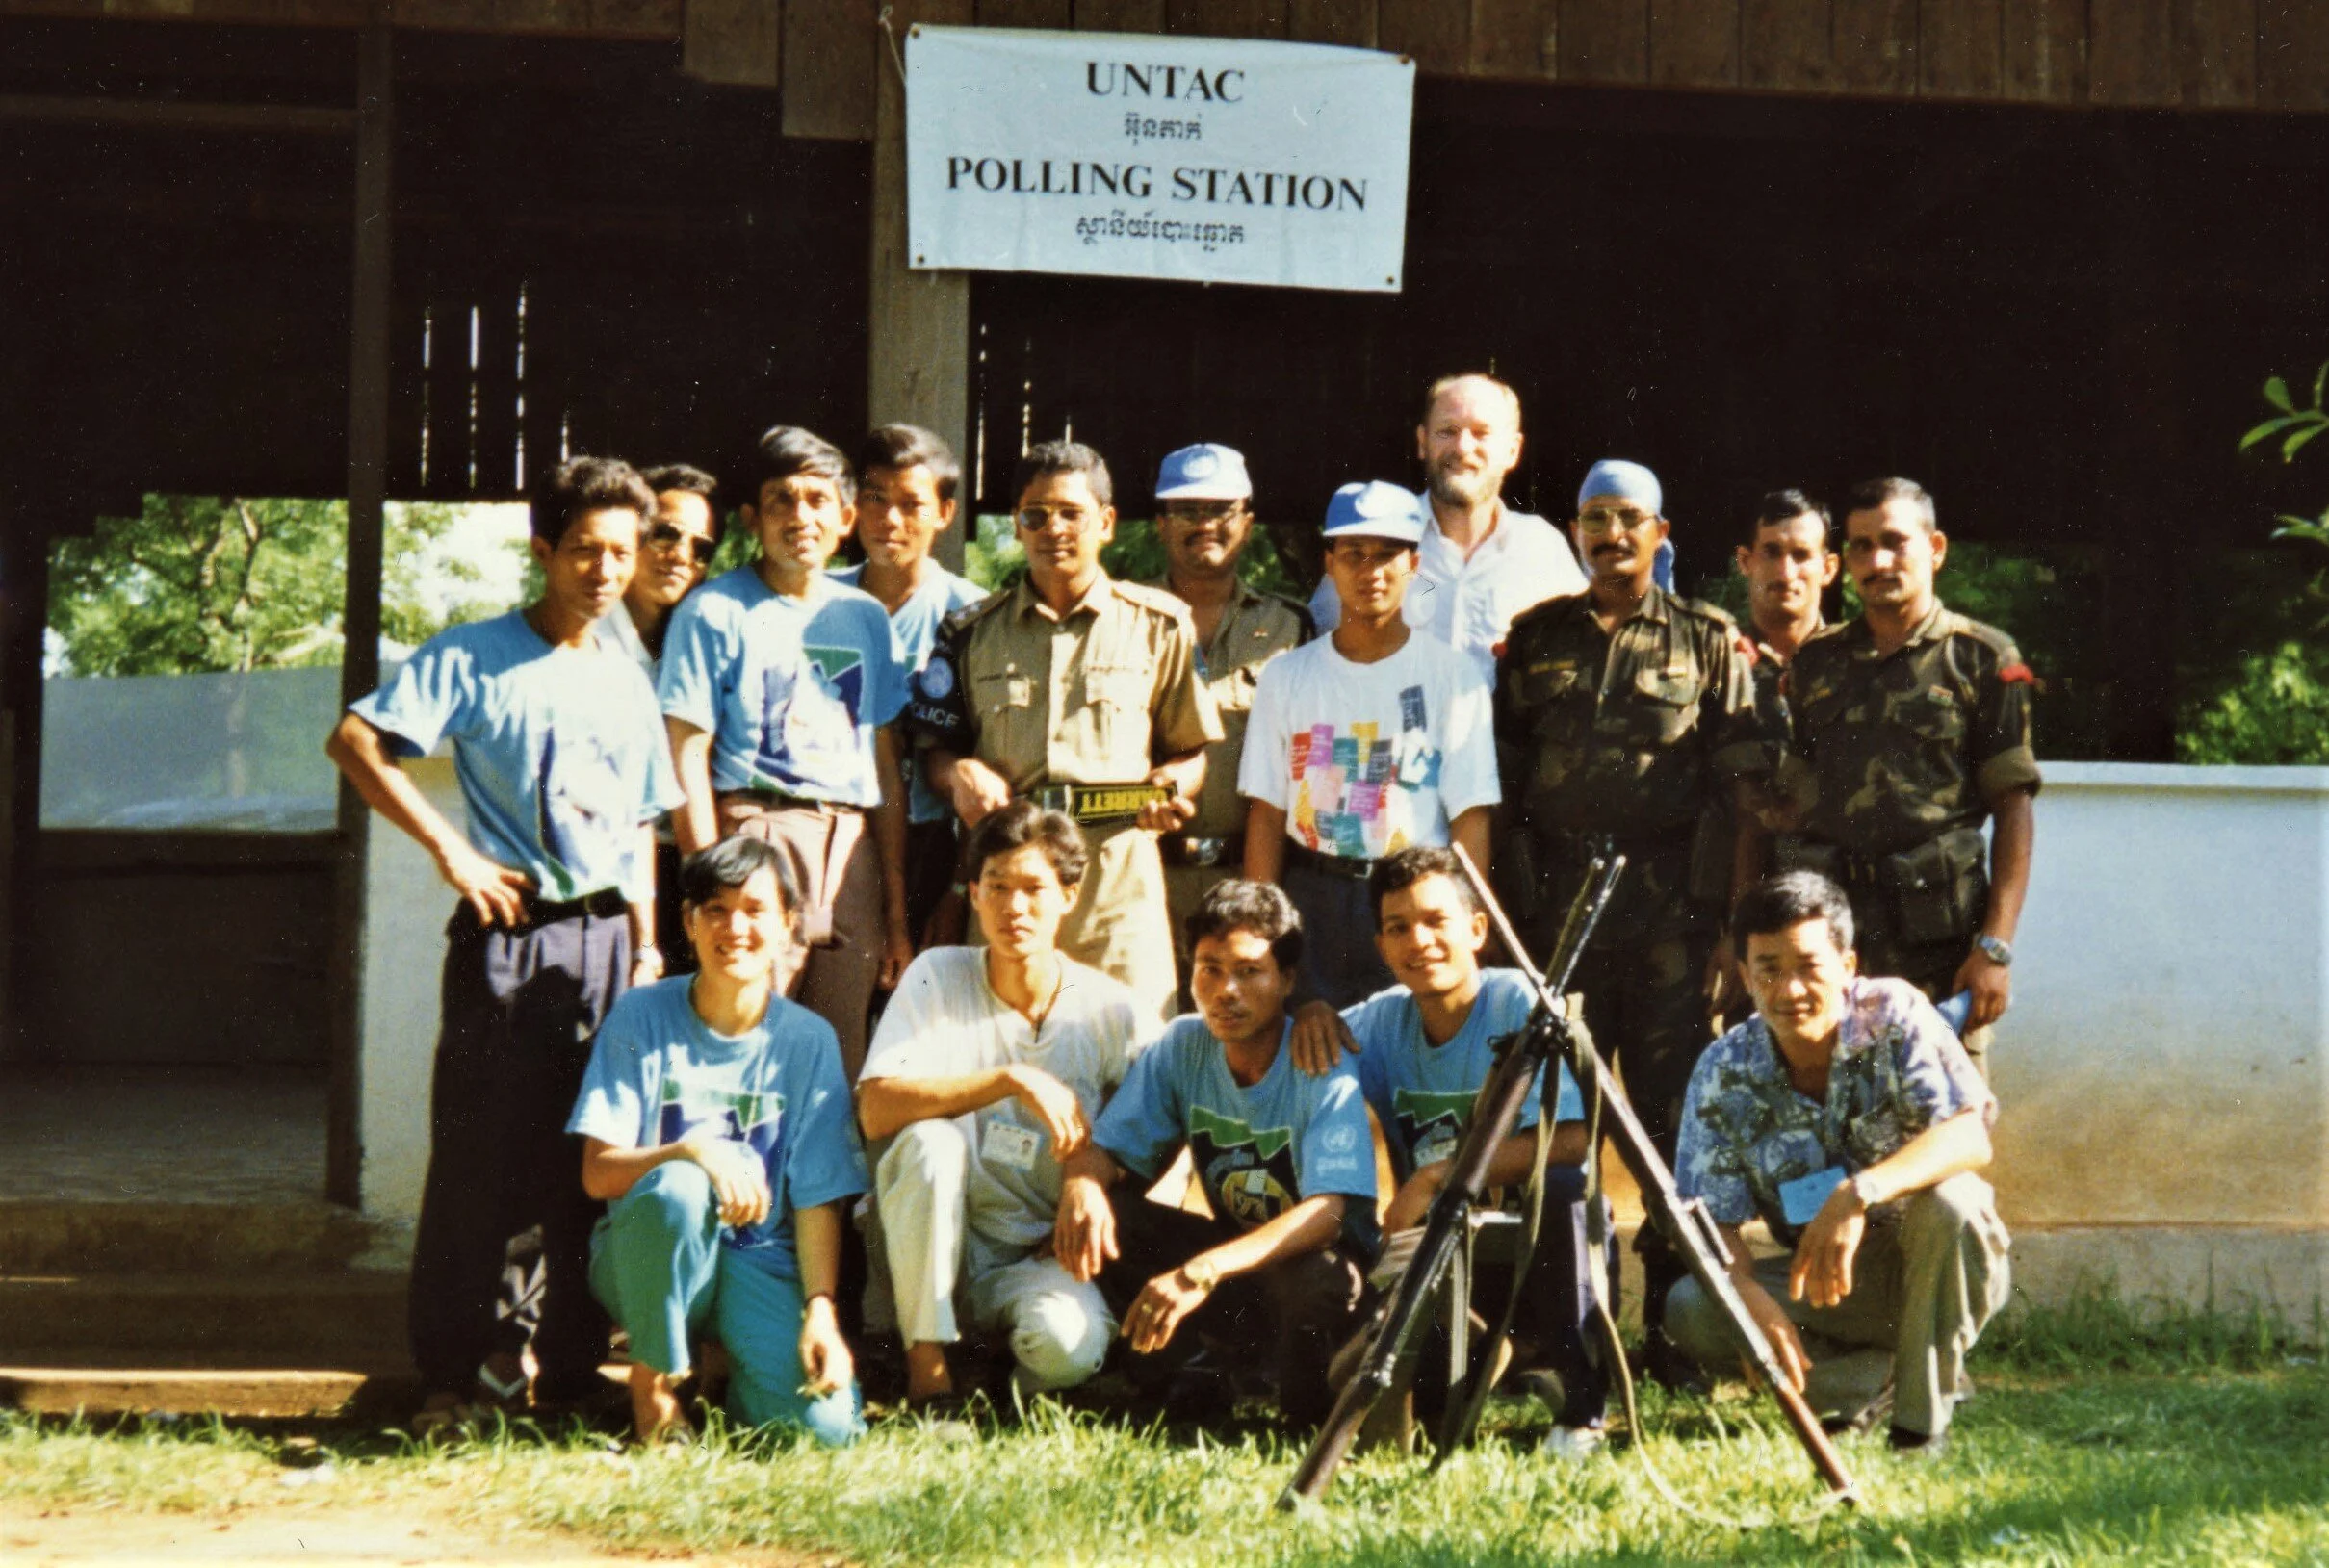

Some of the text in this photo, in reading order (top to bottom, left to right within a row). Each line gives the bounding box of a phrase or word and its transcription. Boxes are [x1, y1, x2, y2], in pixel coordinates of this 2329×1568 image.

[1086, 61, 1245, 103] UNTAC
[946, 155, 1368, 212] POLLING STATION
